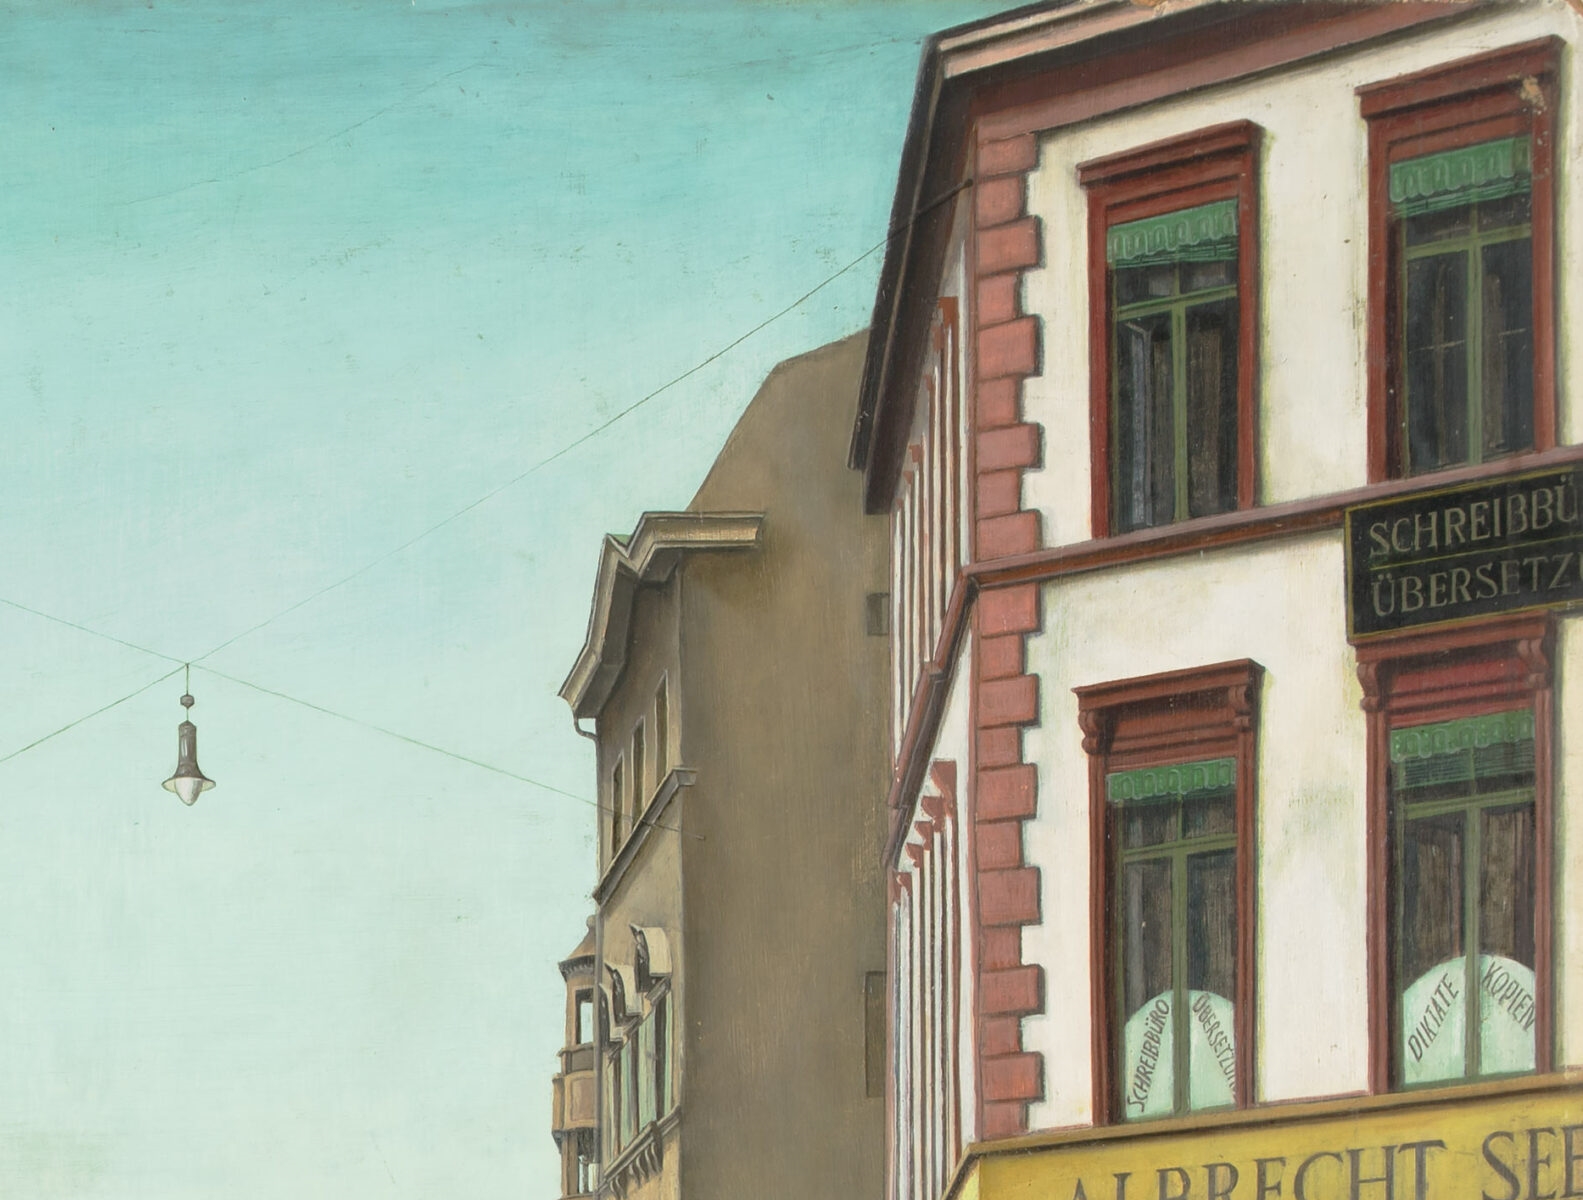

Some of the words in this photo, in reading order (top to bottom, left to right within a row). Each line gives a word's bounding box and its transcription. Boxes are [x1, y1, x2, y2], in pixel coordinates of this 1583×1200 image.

[1407, 972, 1460, 1063] DIKTATE
[1482, 961, 1535, 1032] KOPIEN
[1126, 998, 1170, 1113] SCHREIBBÜRO
